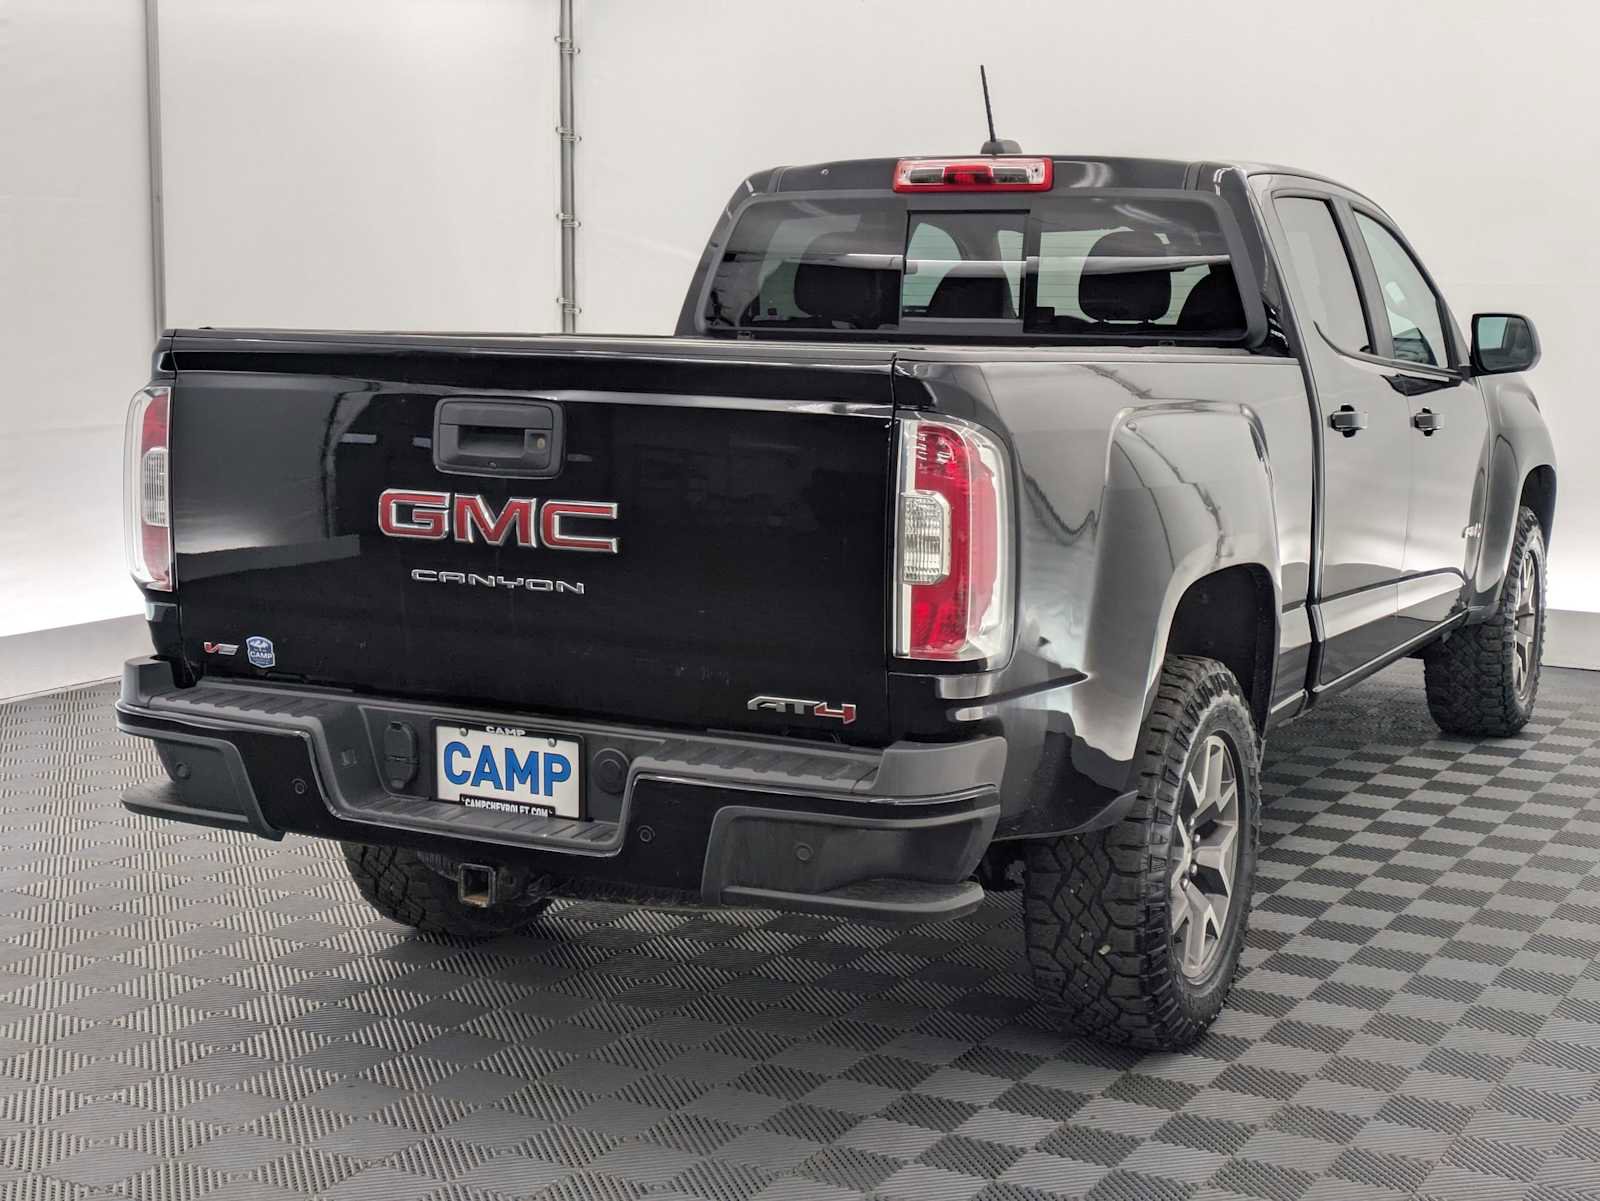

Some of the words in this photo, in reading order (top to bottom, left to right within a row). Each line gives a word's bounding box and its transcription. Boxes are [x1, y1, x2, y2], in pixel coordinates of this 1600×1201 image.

[377, 487, 619, 554] GMC
[411, 568, 585, 595] CANYON
[250, 651, 273, 659] CAMP
[747, 696, 857, 724] AT4
[485, 725, 526, 737] CAMP
[443, 741, 571, 796] CAMP
[464, 798, 549, 817] CAMPCHEVROLETCOM
